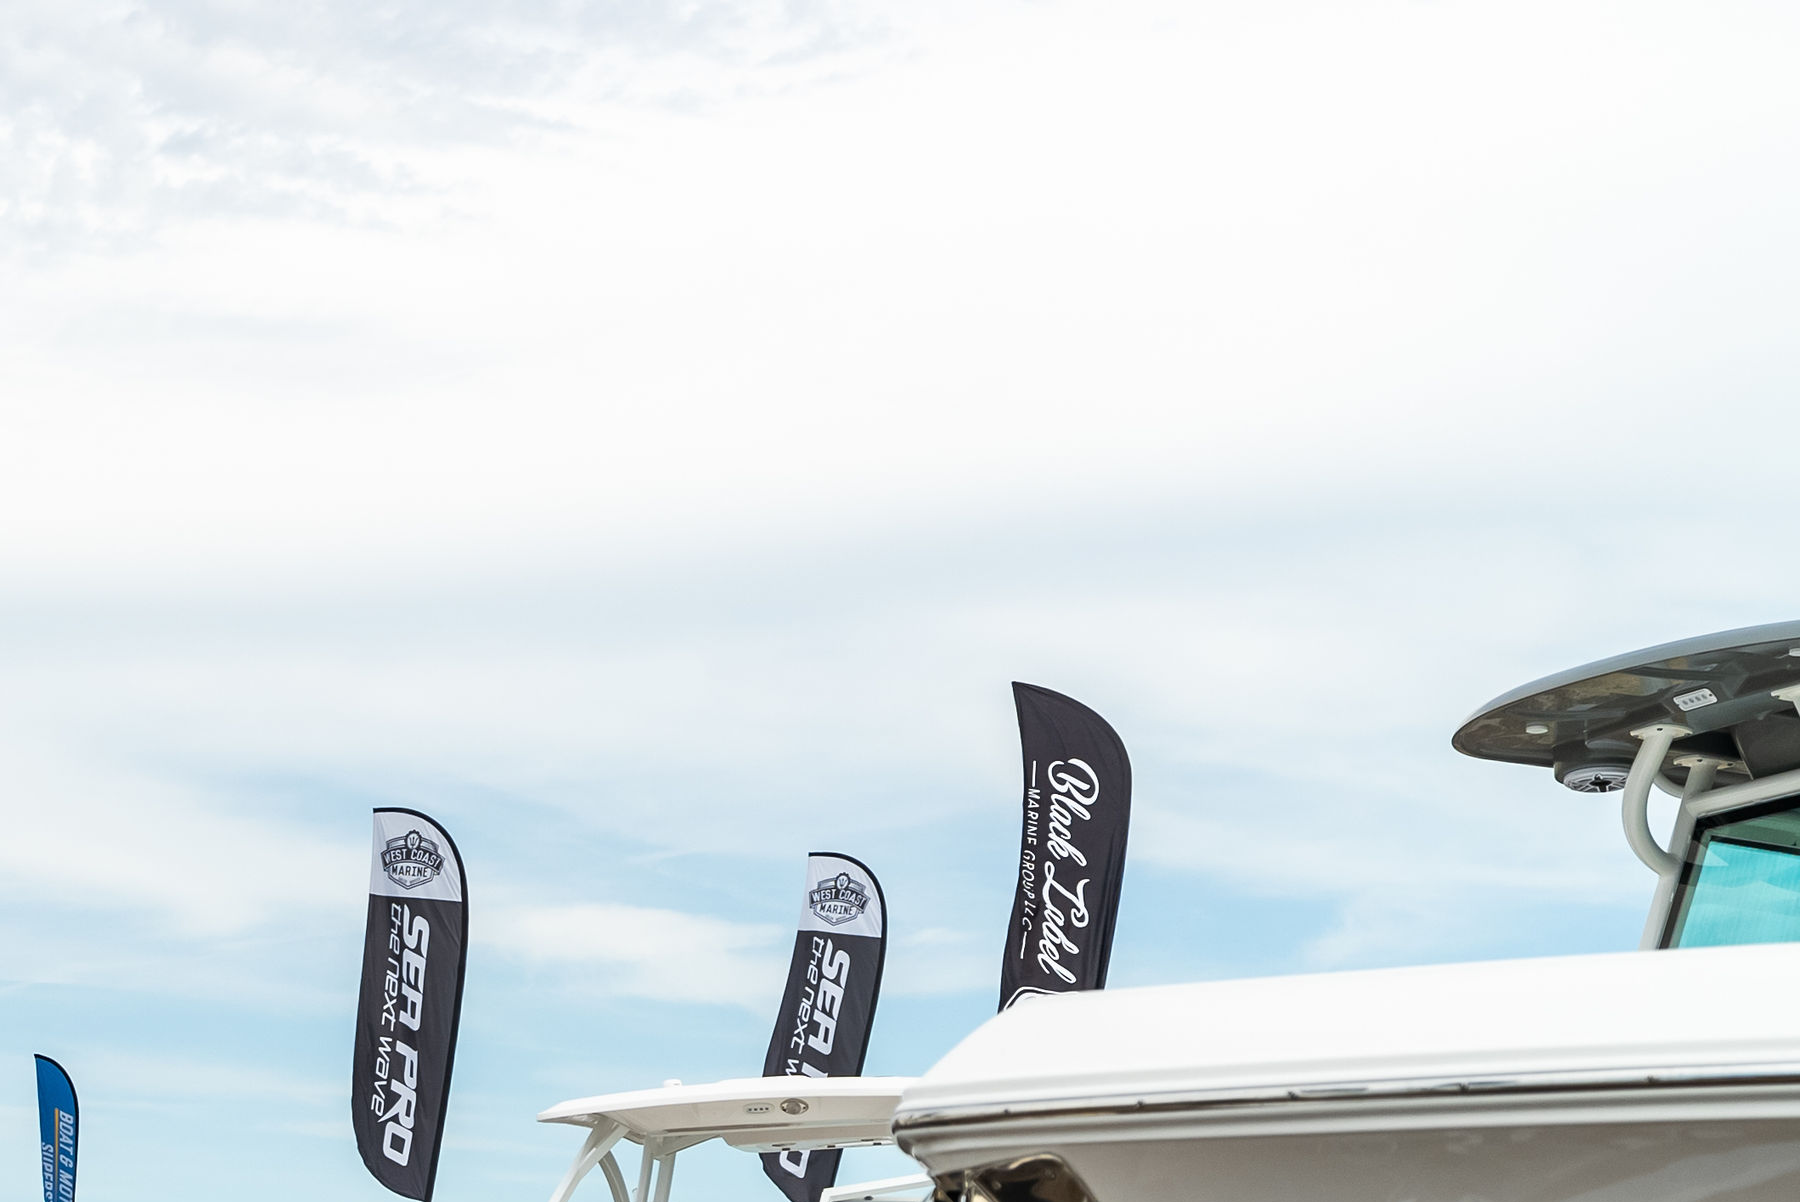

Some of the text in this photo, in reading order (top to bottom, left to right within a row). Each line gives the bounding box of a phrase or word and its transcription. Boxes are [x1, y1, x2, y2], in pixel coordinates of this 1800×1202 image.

[383, 848, 441, 868] WEST COAST
[391, 865, 428, 878] MARINE
[1020, 788, 1041, 932] MARINE GROUP LLC
[1037, 757, 1100, 985] Black Label
[811, 888, 867, 908] WEST COAST
[819, 904, 854, 916] MARINE
[399, 903, 430, 1033] SEA
[806, 934, 826, 986] the
[370, 902, 402, 1117] the next wave
[790, 985, 818, 1055] next
[807, 937, 851, 1056] SEA
[58, 1110, 74, 1156] BOAT
[379, 1040, 419, 1167] PRO
[59, 1156, 74, 1169] &
